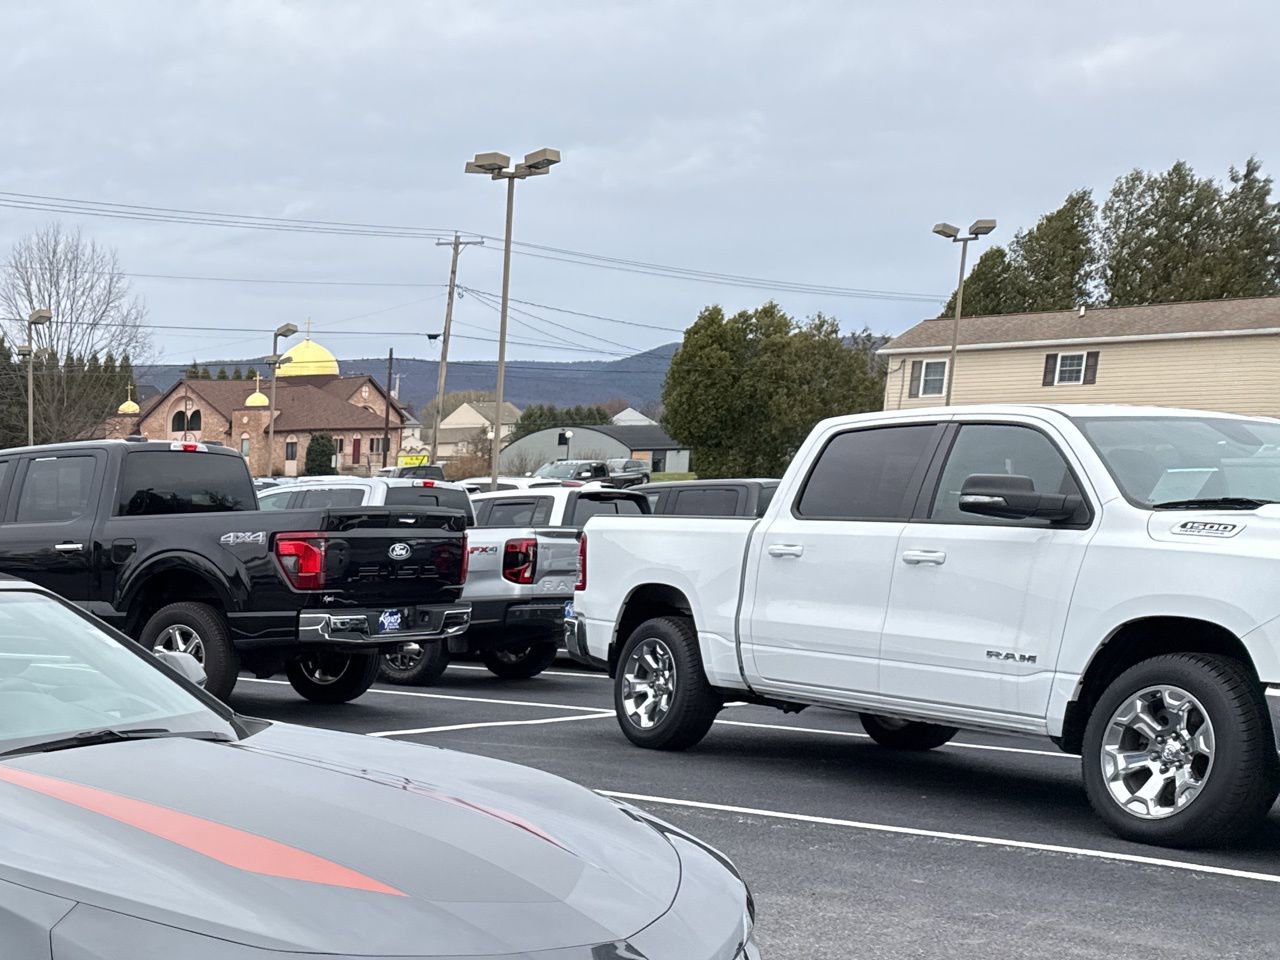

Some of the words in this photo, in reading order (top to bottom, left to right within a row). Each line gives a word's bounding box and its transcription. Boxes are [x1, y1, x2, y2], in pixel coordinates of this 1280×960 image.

[1183, 521, 1235, 532] 1500
[469, 546, 498, 555] FX4
[542, 580, 571, 592] RA
[986, 650, 1037, 664] RAM
